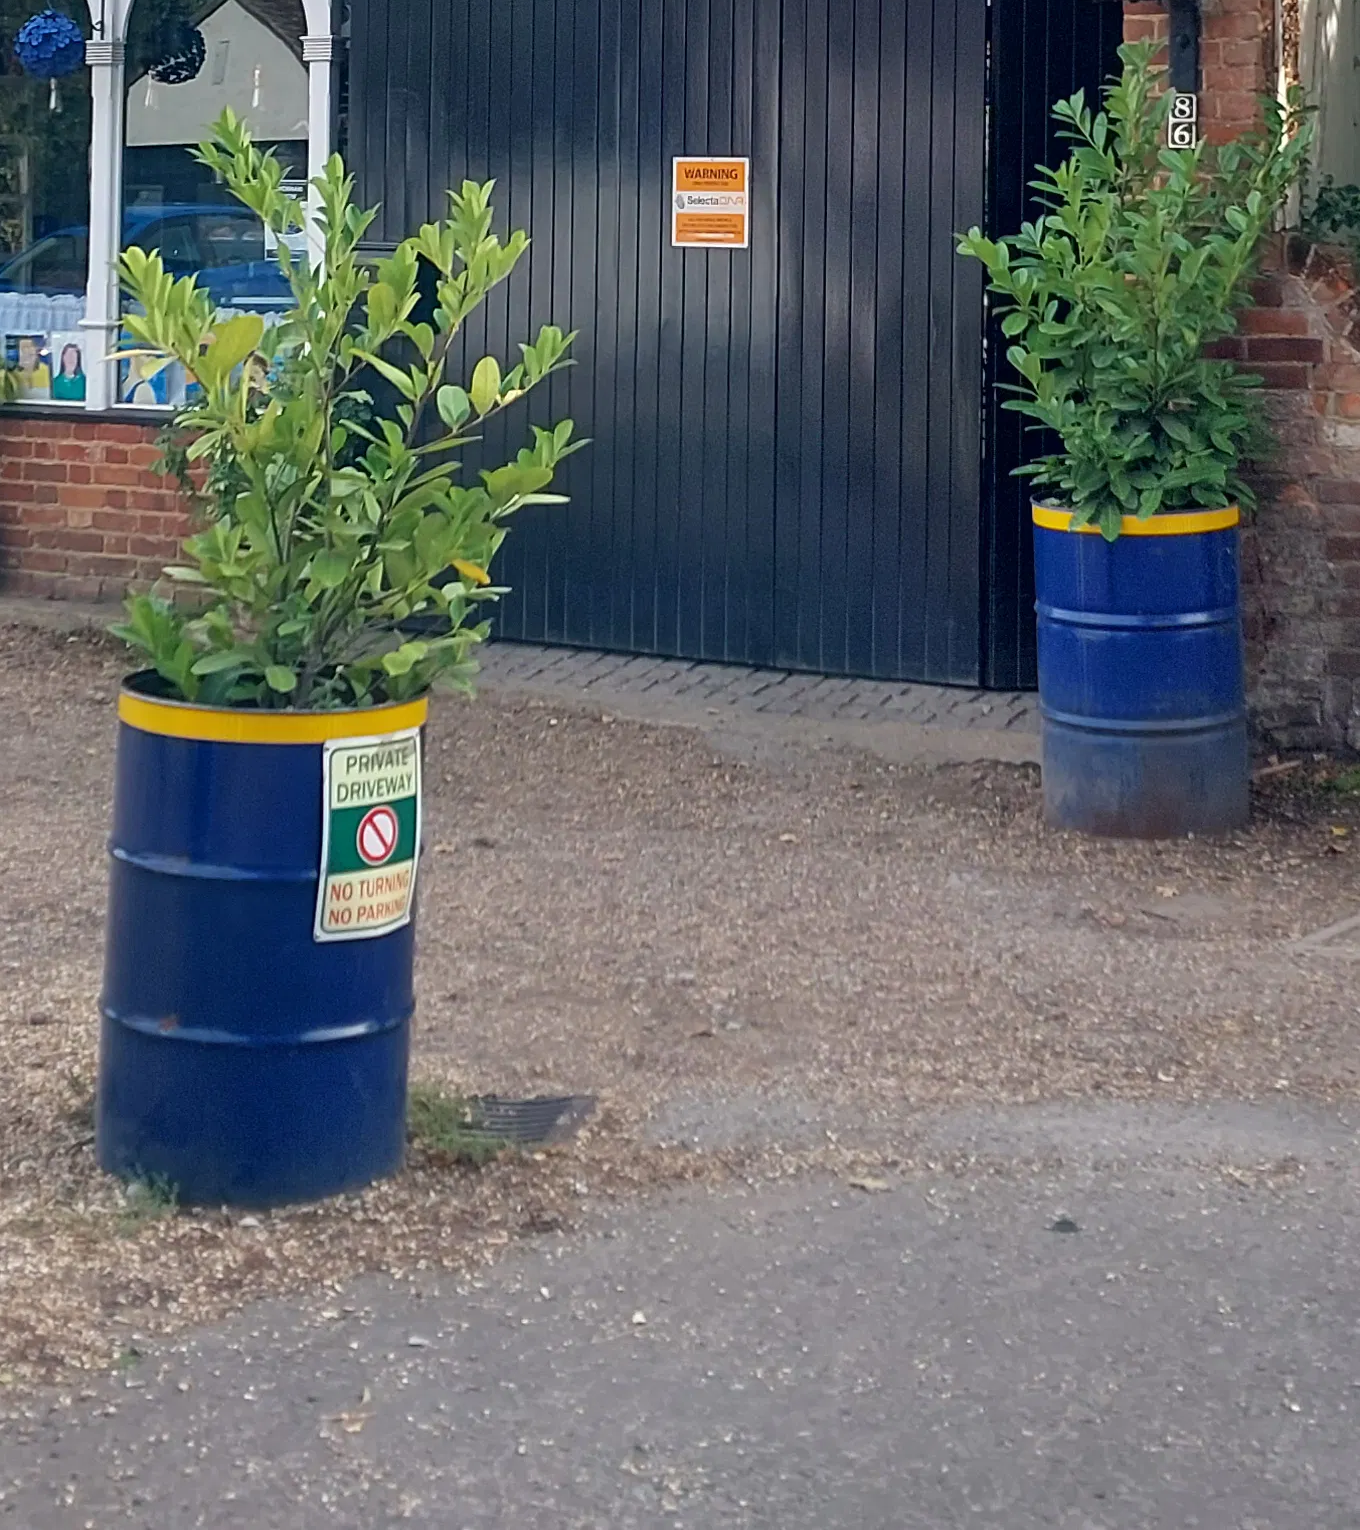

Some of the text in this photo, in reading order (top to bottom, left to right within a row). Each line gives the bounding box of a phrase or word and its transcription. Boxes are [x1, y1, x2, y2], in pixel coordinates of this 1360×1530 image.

[1174, 97, 1191, 145] 86
[684, 168, 738, 180] WARNING
[346, 746, 409, 775] PRIVATE
[336, 773, 413, 803] DRIVEWAY
[330, 870, 410, 902] NO TURNING
[328, 896, 406, 926] NO PARKING
